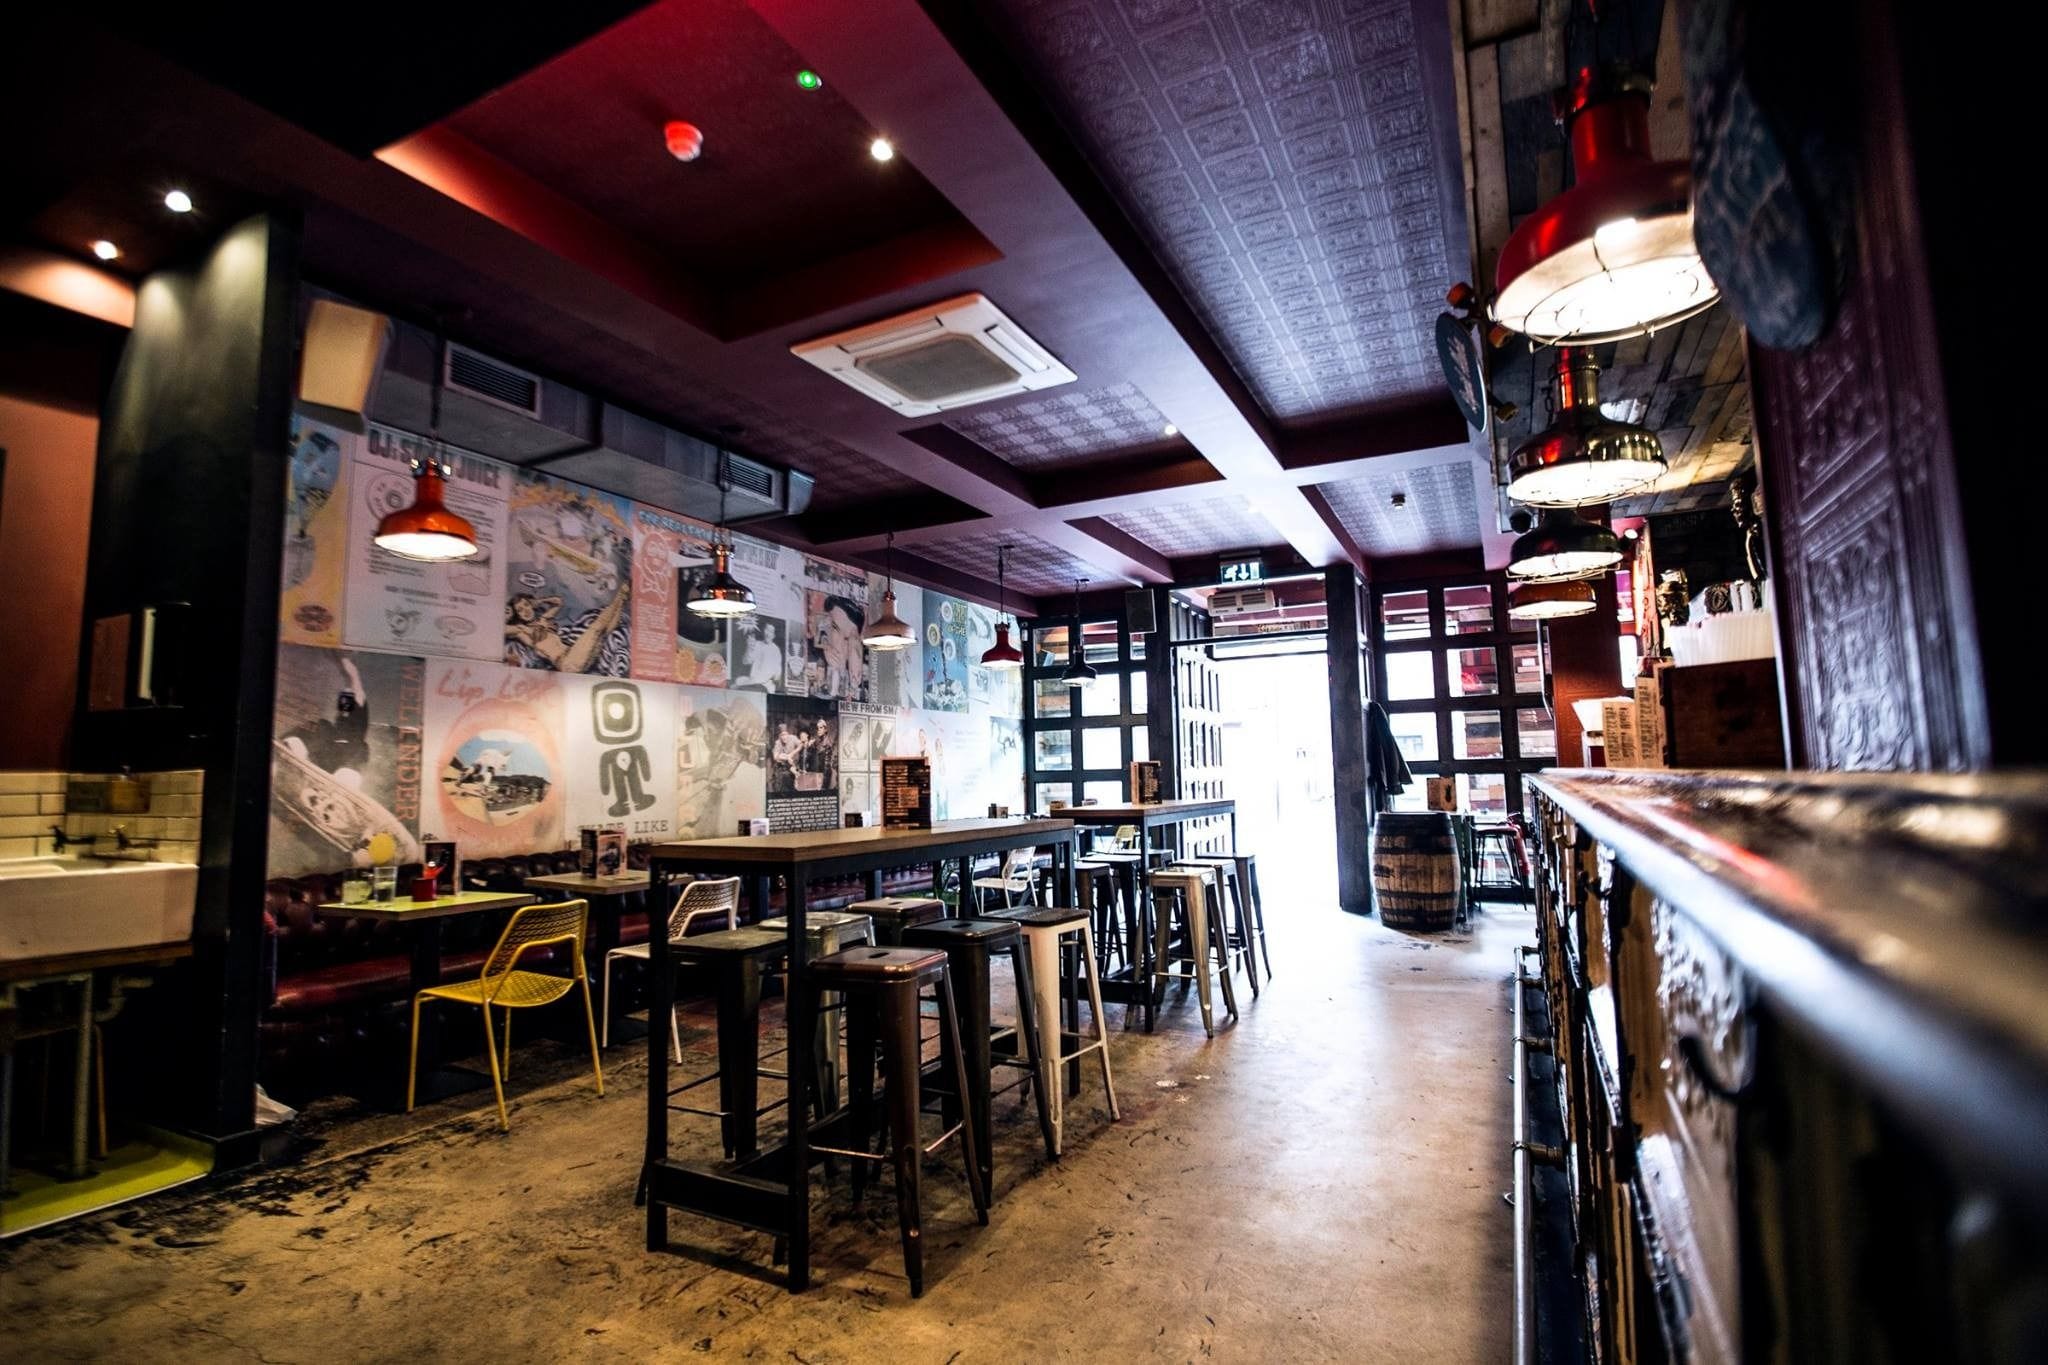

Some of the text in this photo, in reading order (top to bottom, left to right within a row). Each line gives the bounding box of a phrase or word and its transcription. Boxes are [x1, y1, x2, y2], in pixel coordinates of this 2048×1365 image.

[840, 702, 858, 713] NEW
[860, 703, 881, 713] FROM
[636, 820, 668, 833] LIKE
